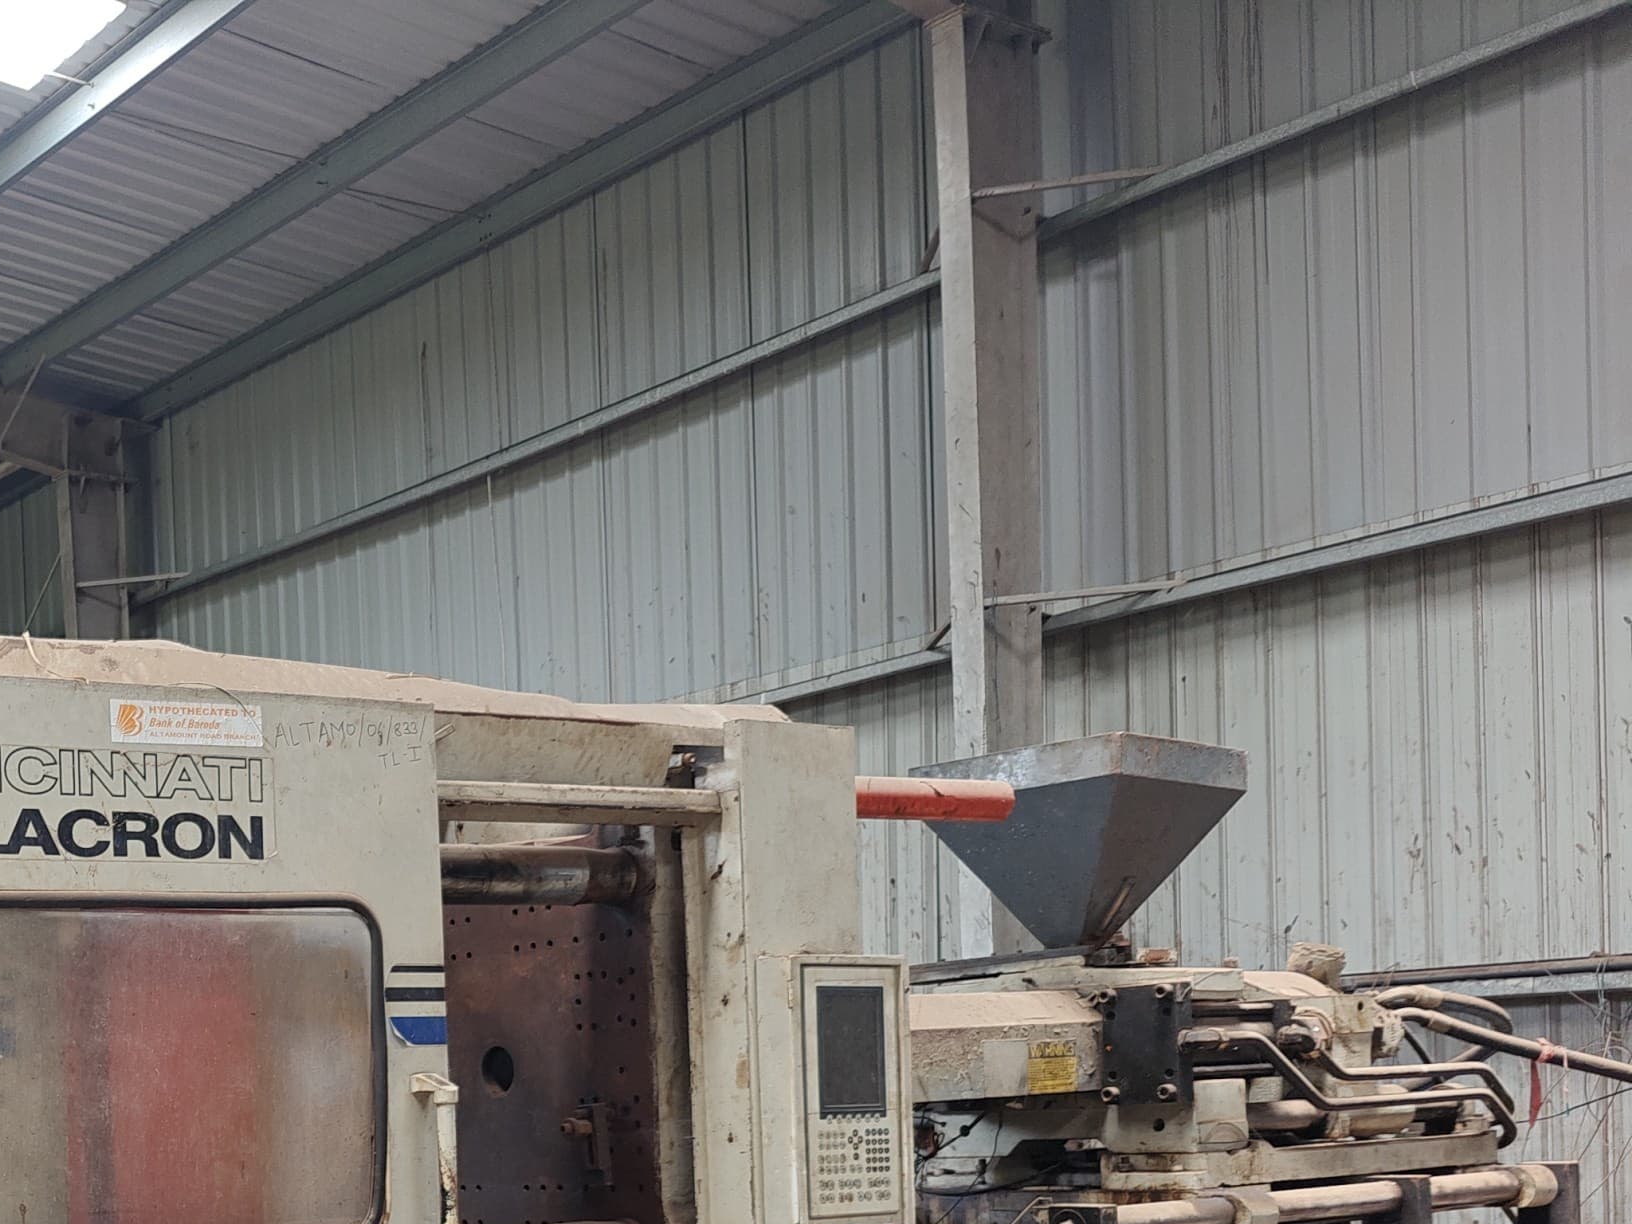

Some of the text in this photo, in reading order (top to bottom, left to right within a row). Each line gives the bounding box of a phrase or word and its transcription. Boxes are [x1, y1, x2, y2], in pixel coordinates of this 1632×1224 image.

[148, 705, 256, 718] HYPOTHECATED TO
[148, 717, 173, 729] Bank
[187, 719, 220, 730] Baroda
[149, 731, 198, 740] ALTAMOUNT
